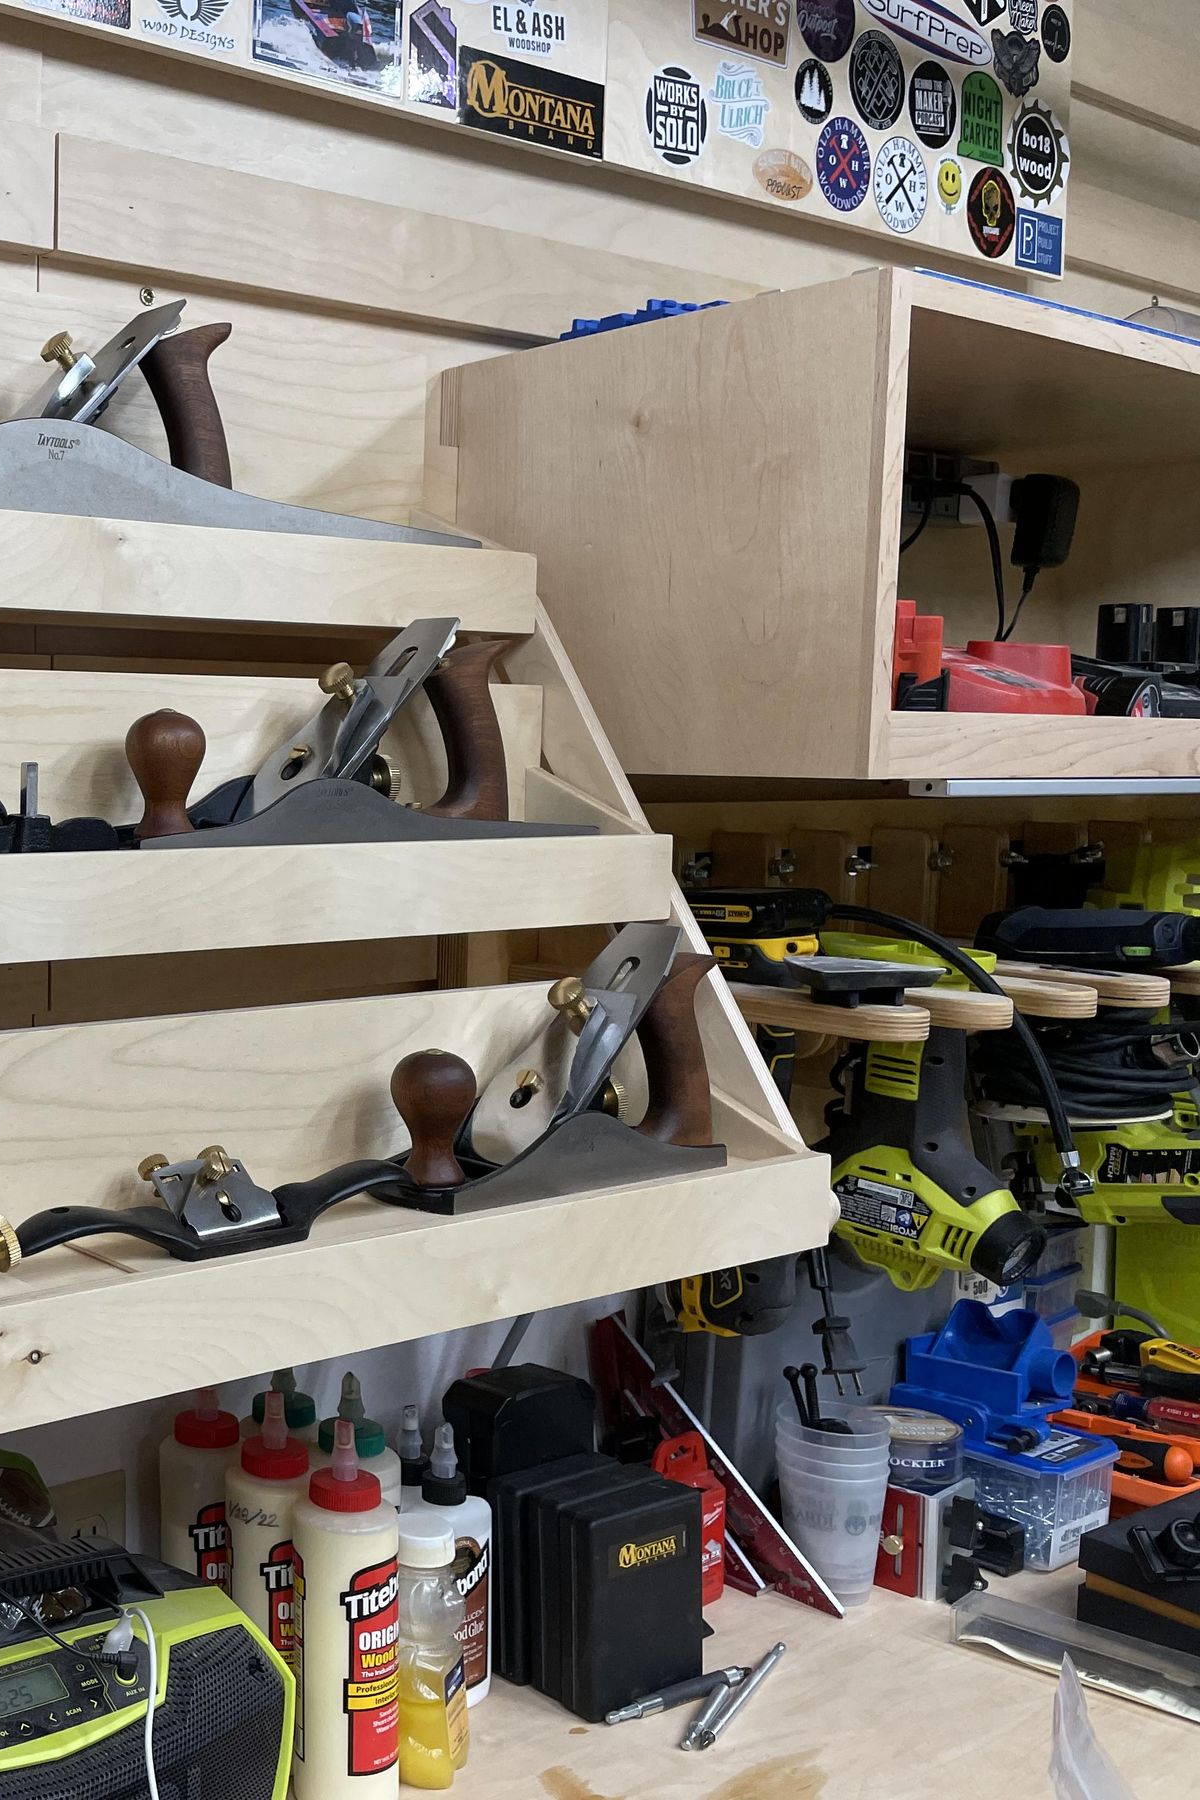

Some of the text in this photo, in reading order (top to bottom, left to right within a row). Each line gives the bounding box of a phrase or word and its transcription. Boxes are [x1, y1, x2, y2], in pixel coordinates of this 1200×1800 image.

[142, 19, 235, 50] WOOD DESIGNS
[492, 5, 565, 41] EL & ASH
[508, 37, 551, 53] WOODSHOP
[467, 60, 595, 136] MONTANA
[655, 79, 698, 108] WORKS
[715, 75, 754, 99] BRUCE
[670, 104, 685, 118] BY
[915, 89, 944, 113] MAKER
[964, 91, 1000, 124] NIGHT
[720, 104, 763, 129] ULRICH
[916, 111, 944, 127] PODCAST
[508, 120, 593, 149] BRAND
[655, 115, 698, 152] SOLO
[818, 126, 833, 158] OLD
[835, 118, 870, 170] HAMMER
[963, 119, 999, 151] CARVER
[1022, 127, 1051, 154] bo18
[876, 146, 890, 178] OLD
[892, 138, 926, 191] HAMMER
[1019, 156, 1052, 180] wood
[819, 170, 868, 210] WOODWORK
[876, 190, 926, 230] WOODWORK
[889, 1223, 918, 1239] RYOBI
[973, 1279, 988, 1296] 500
[889, 1456, 946, 1469] OCKLER
[618, 1537, 677, 1568] MONTANA
[456, 1547, 488, 1597] bond
[345, 1571, 399, 1620] Titeb
[463, 1605, 485, 1623] LUCENT
[468, 1619, 485, 1640] Glue
[360, 1645, 395, 1669] Wood
[81, 1678, 99, 1688] MODE
[126, 1689, 138, 1697] AUX
[65, 1707, 82, 1717] SCAN
